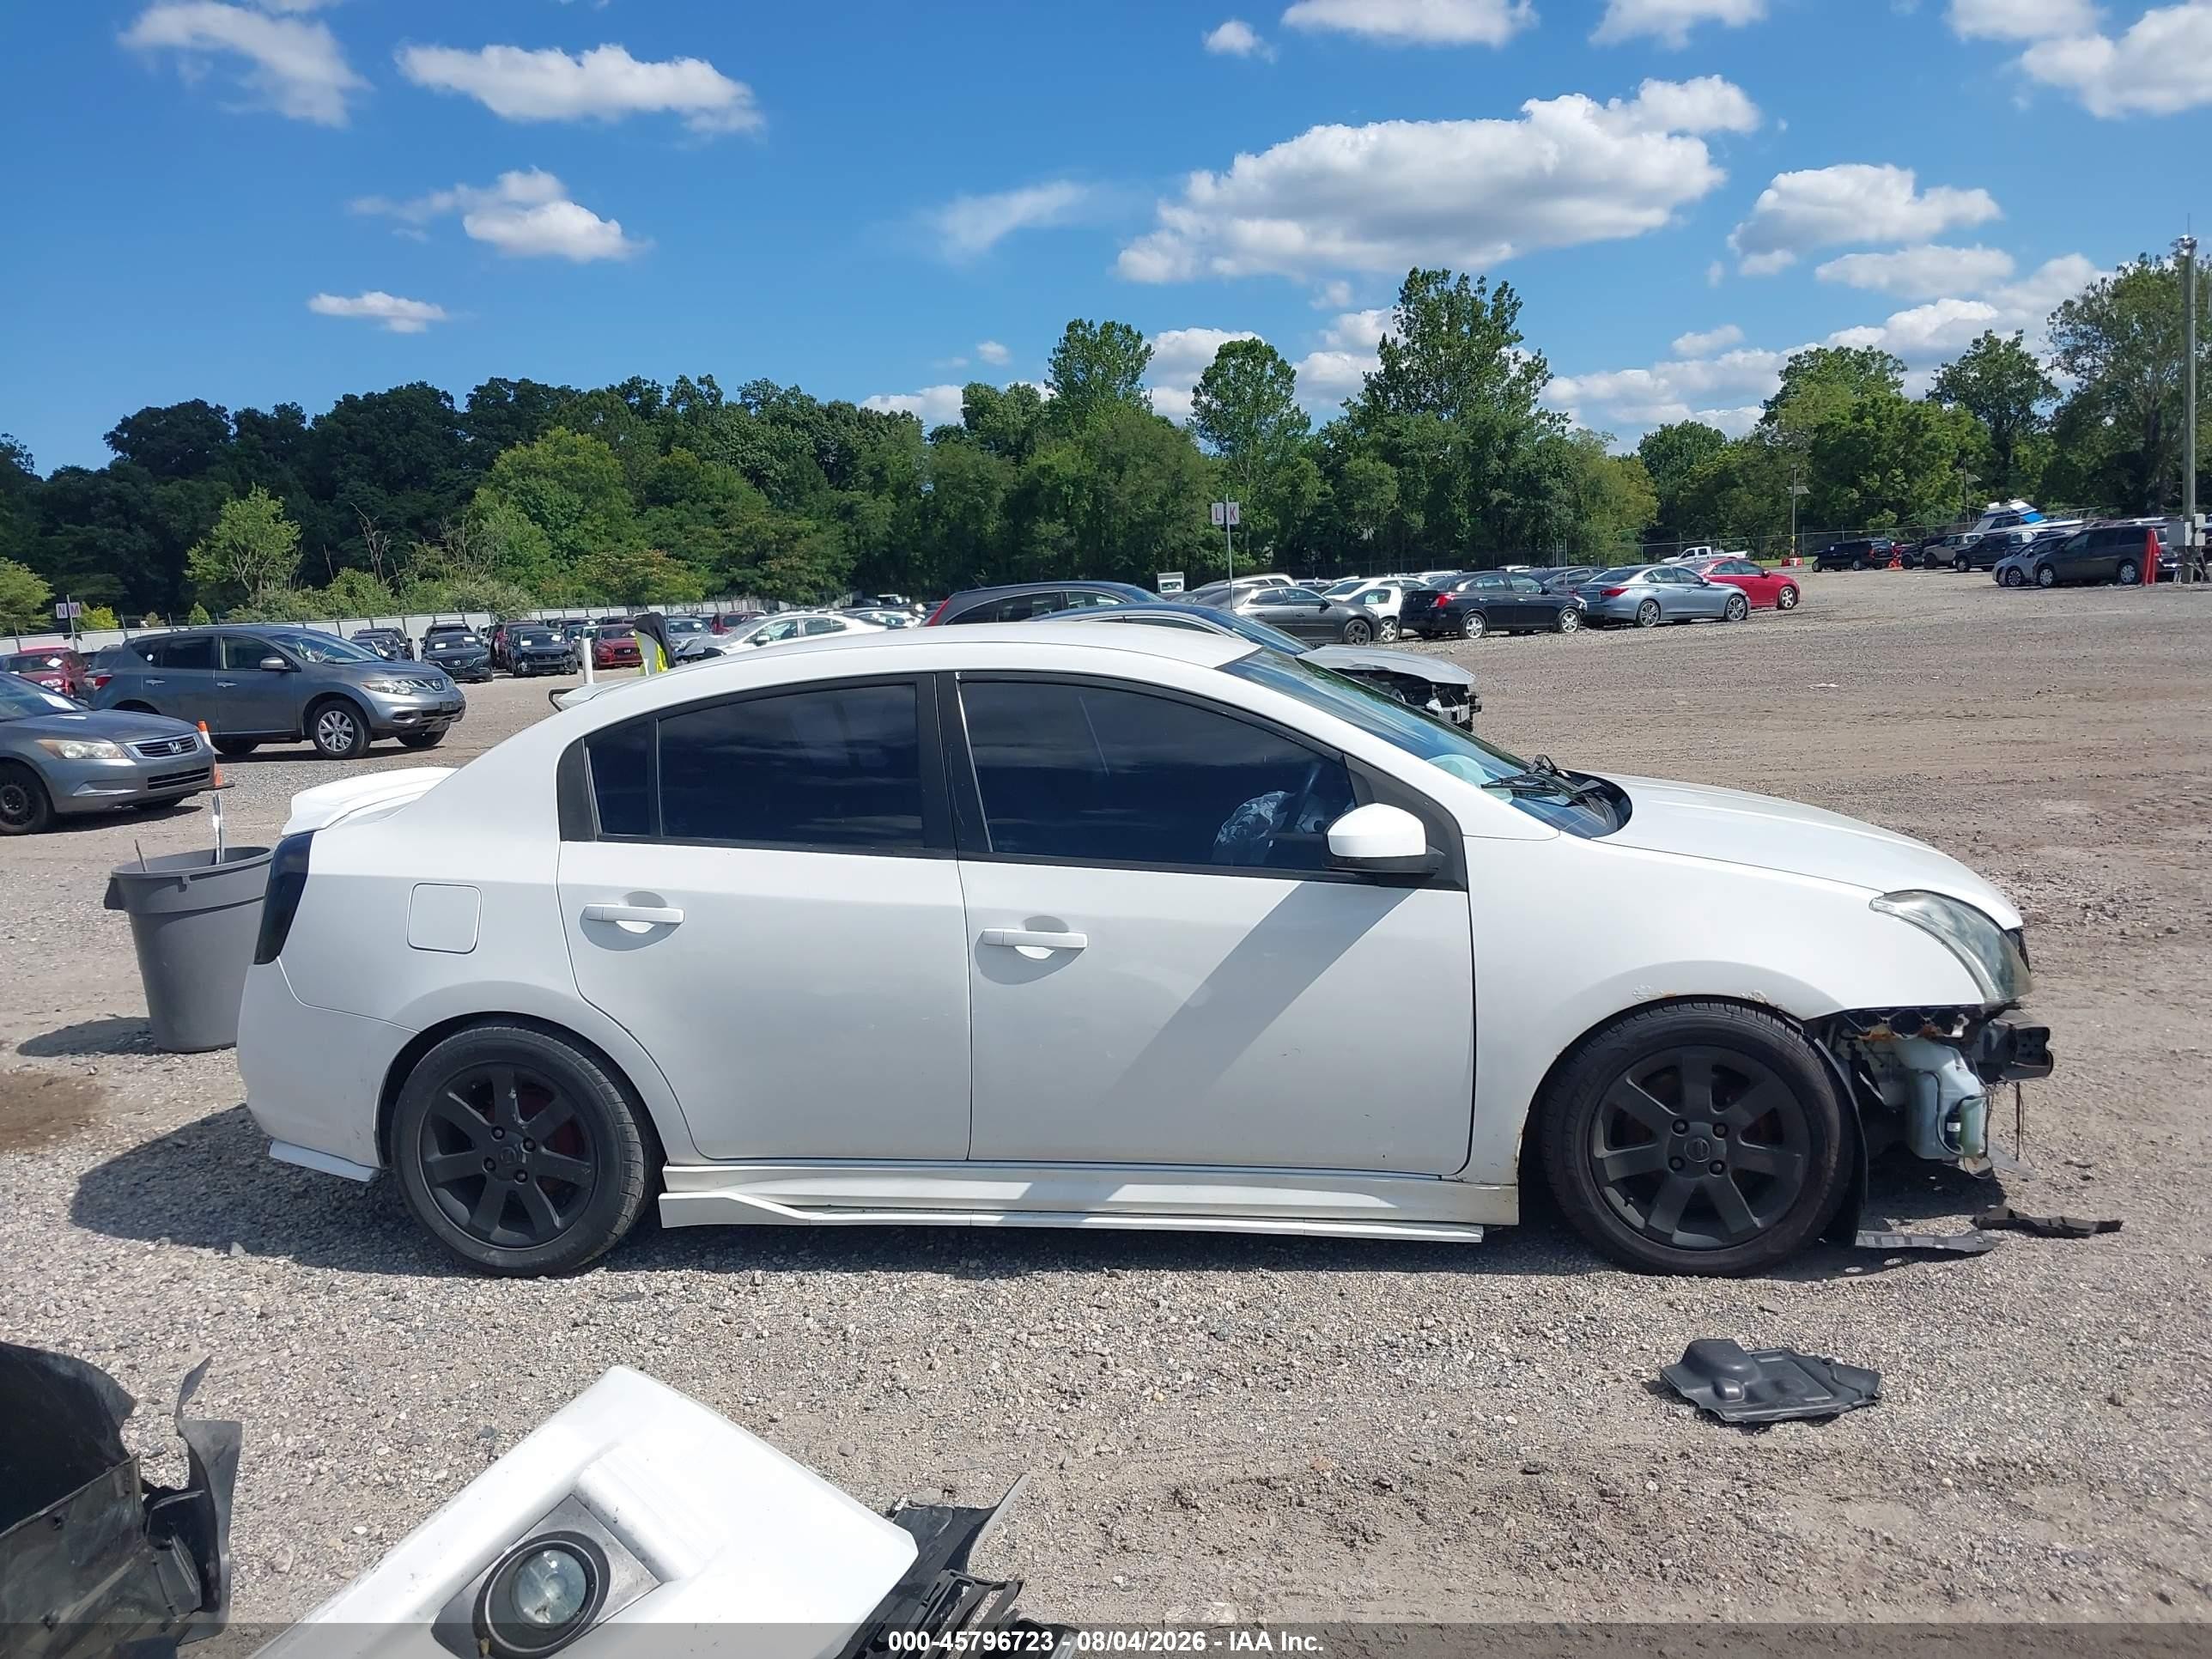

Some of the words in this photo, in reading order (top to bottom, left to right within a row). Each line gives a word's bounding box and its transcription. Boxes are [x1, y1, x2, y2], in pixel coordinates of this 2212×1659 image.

[1215, 507, 1221, 521] L
[1230, 507, 1237, 521] K
[58, 605, 65, 616] N
[70, 605, 80, 616] M
